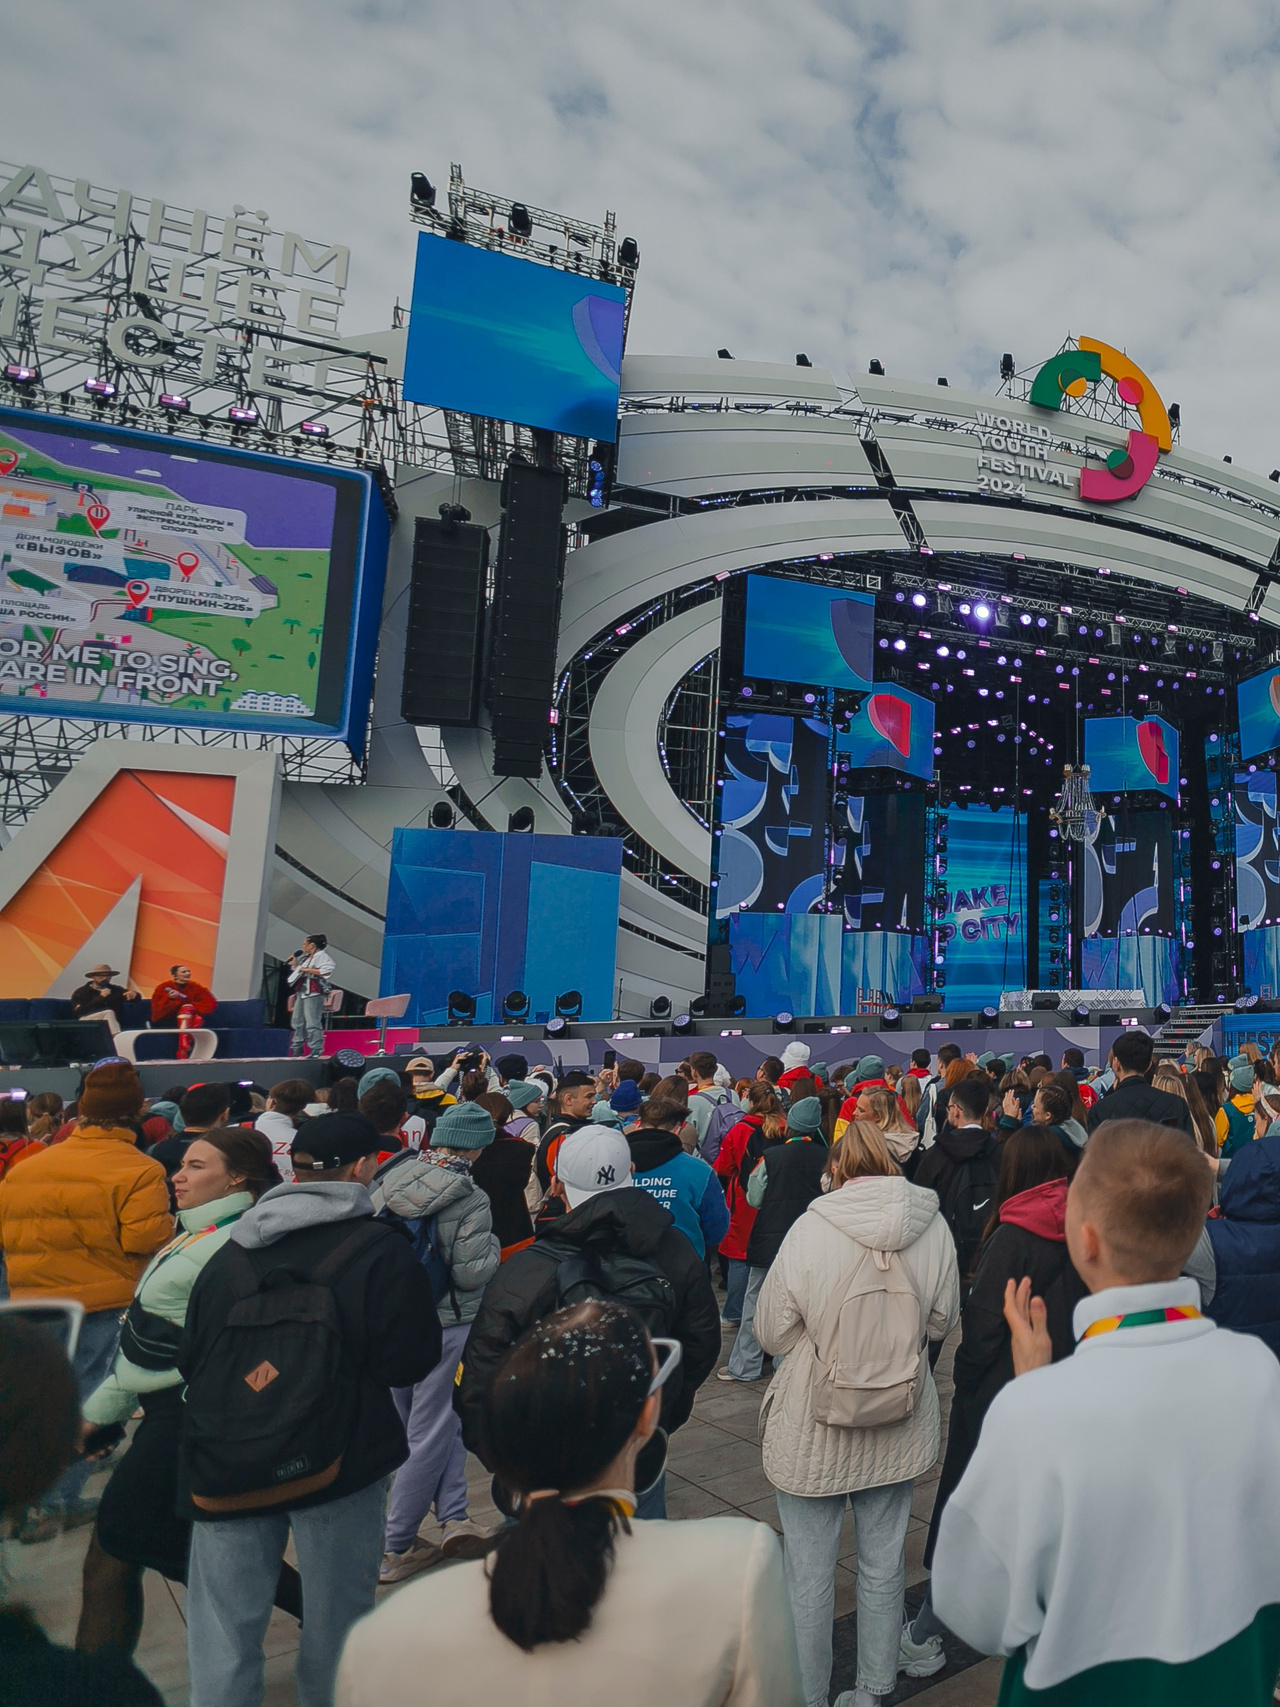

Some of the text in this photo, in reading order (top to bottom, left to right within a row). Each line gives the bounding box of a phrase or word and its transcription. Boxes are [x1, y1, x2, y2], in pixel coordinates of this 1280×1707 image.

[975, 411, 1051, 441] WORLD
[977, 432, 1049, 460] YOUTH
[977, 454, 1074, 489] FESTIVAL
[977, 475, 1027, 497] 2024
[166, 502, 200, 514] ПАРК
[16, 533, 40, 541] ДОМ
[15, 542, 102, 560] «ВЫЗОВ»
[1, 599, 51, 610] ПЛОЩАДЬ
[149, 594, 253, 612] «ПУШКИН-225»
[154, 586, 250, 603] ДВОРЕЦ КУЛЬТУРЫ
[19, 610, 76, 622] РОССИИ»
[52, 643, 102, 665] ME
[109, 649, 152, 669] TO
[160, 654, 239, 682] SING,
[0, 660, 224, 697] ARE IN FRONT
[927, 884, 1008, 920] AKE
[961, 912, 1021, 943] CITY
[596, 1164, 616, 1186] NY
[631, 1177, 672, 1188] ILDING
